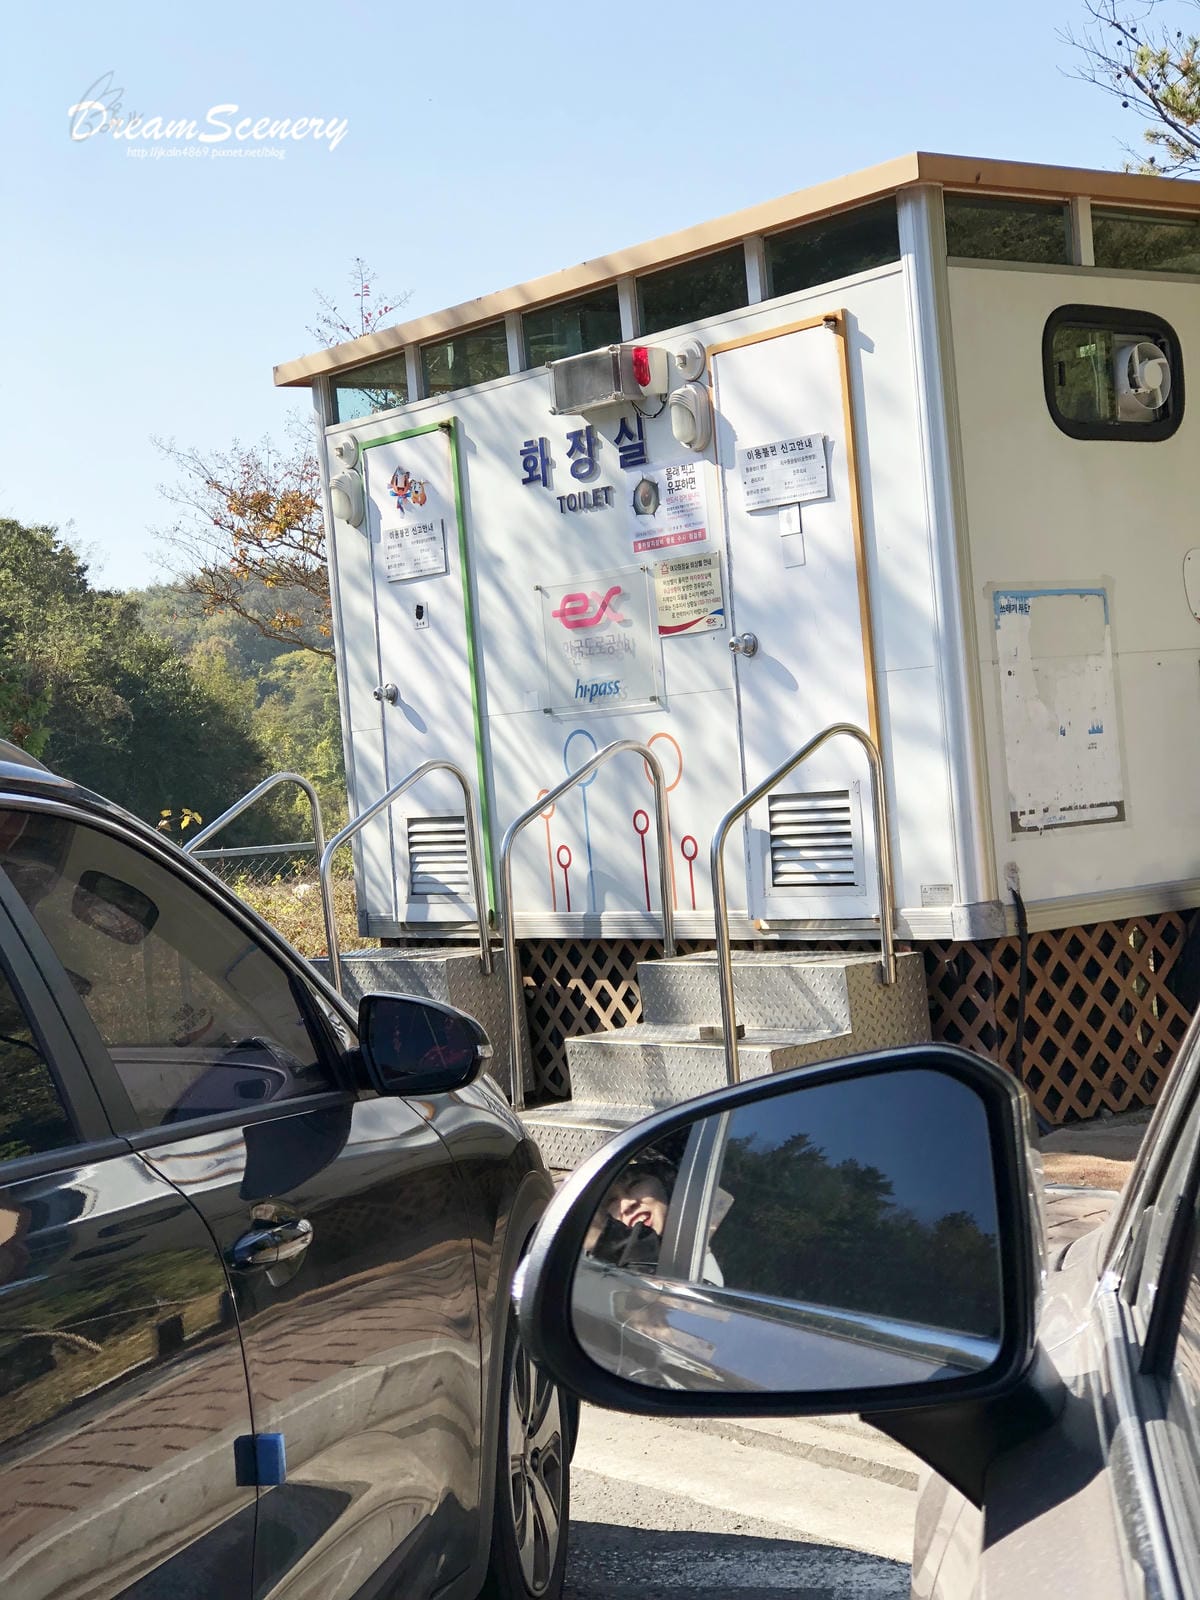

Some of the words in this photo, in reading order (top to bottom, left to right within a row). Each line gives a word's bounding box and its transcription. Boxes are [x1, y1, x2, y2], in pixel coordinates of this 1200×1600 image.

[746, 445, 778, 461] 이용불편
[780, 438, 813, 454] 신고안내
[665, 467, 680, 481] 몰래
[666, 477, 697, 495] 유포하면
[557, 486, 612, 514] TOILET
[551, 585, 625, 629] ex
